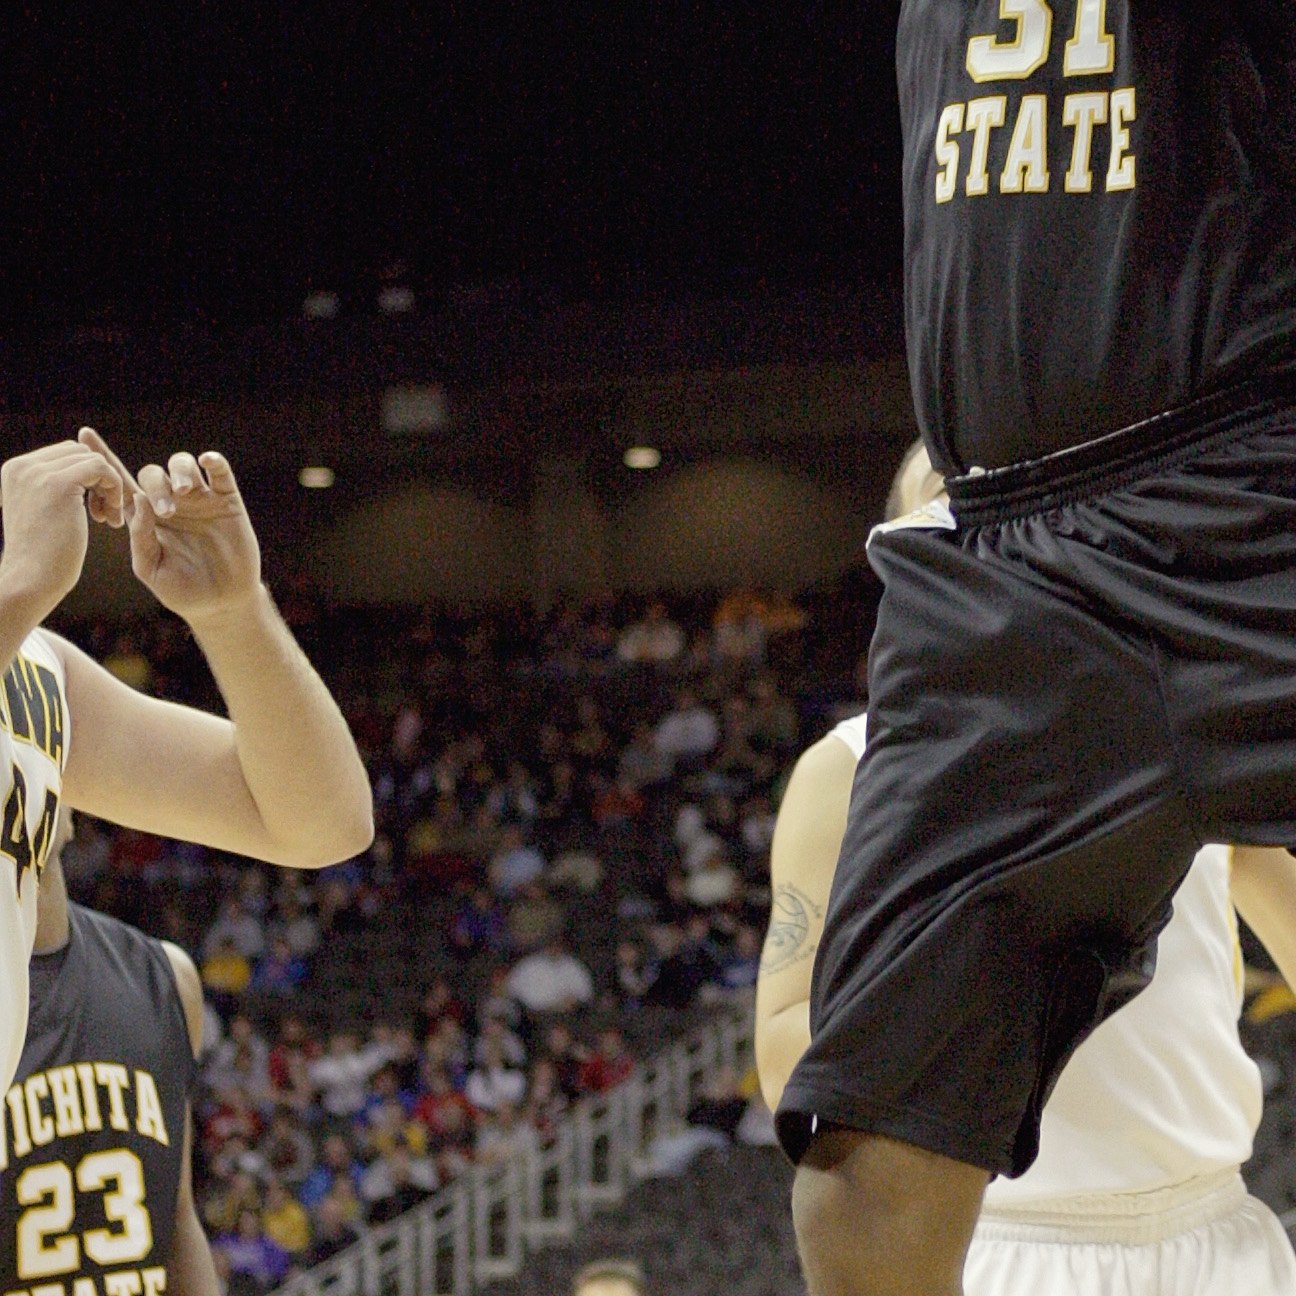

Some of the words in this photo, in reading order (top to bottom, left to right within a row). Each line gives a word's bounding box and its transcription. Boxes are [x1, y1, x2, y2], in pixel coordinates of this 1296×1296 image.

[935, 87, 1136, 204] STATE
[0, 1059, 170, 1172] ICHITA
[15, 1148, 154, 1281] 23
